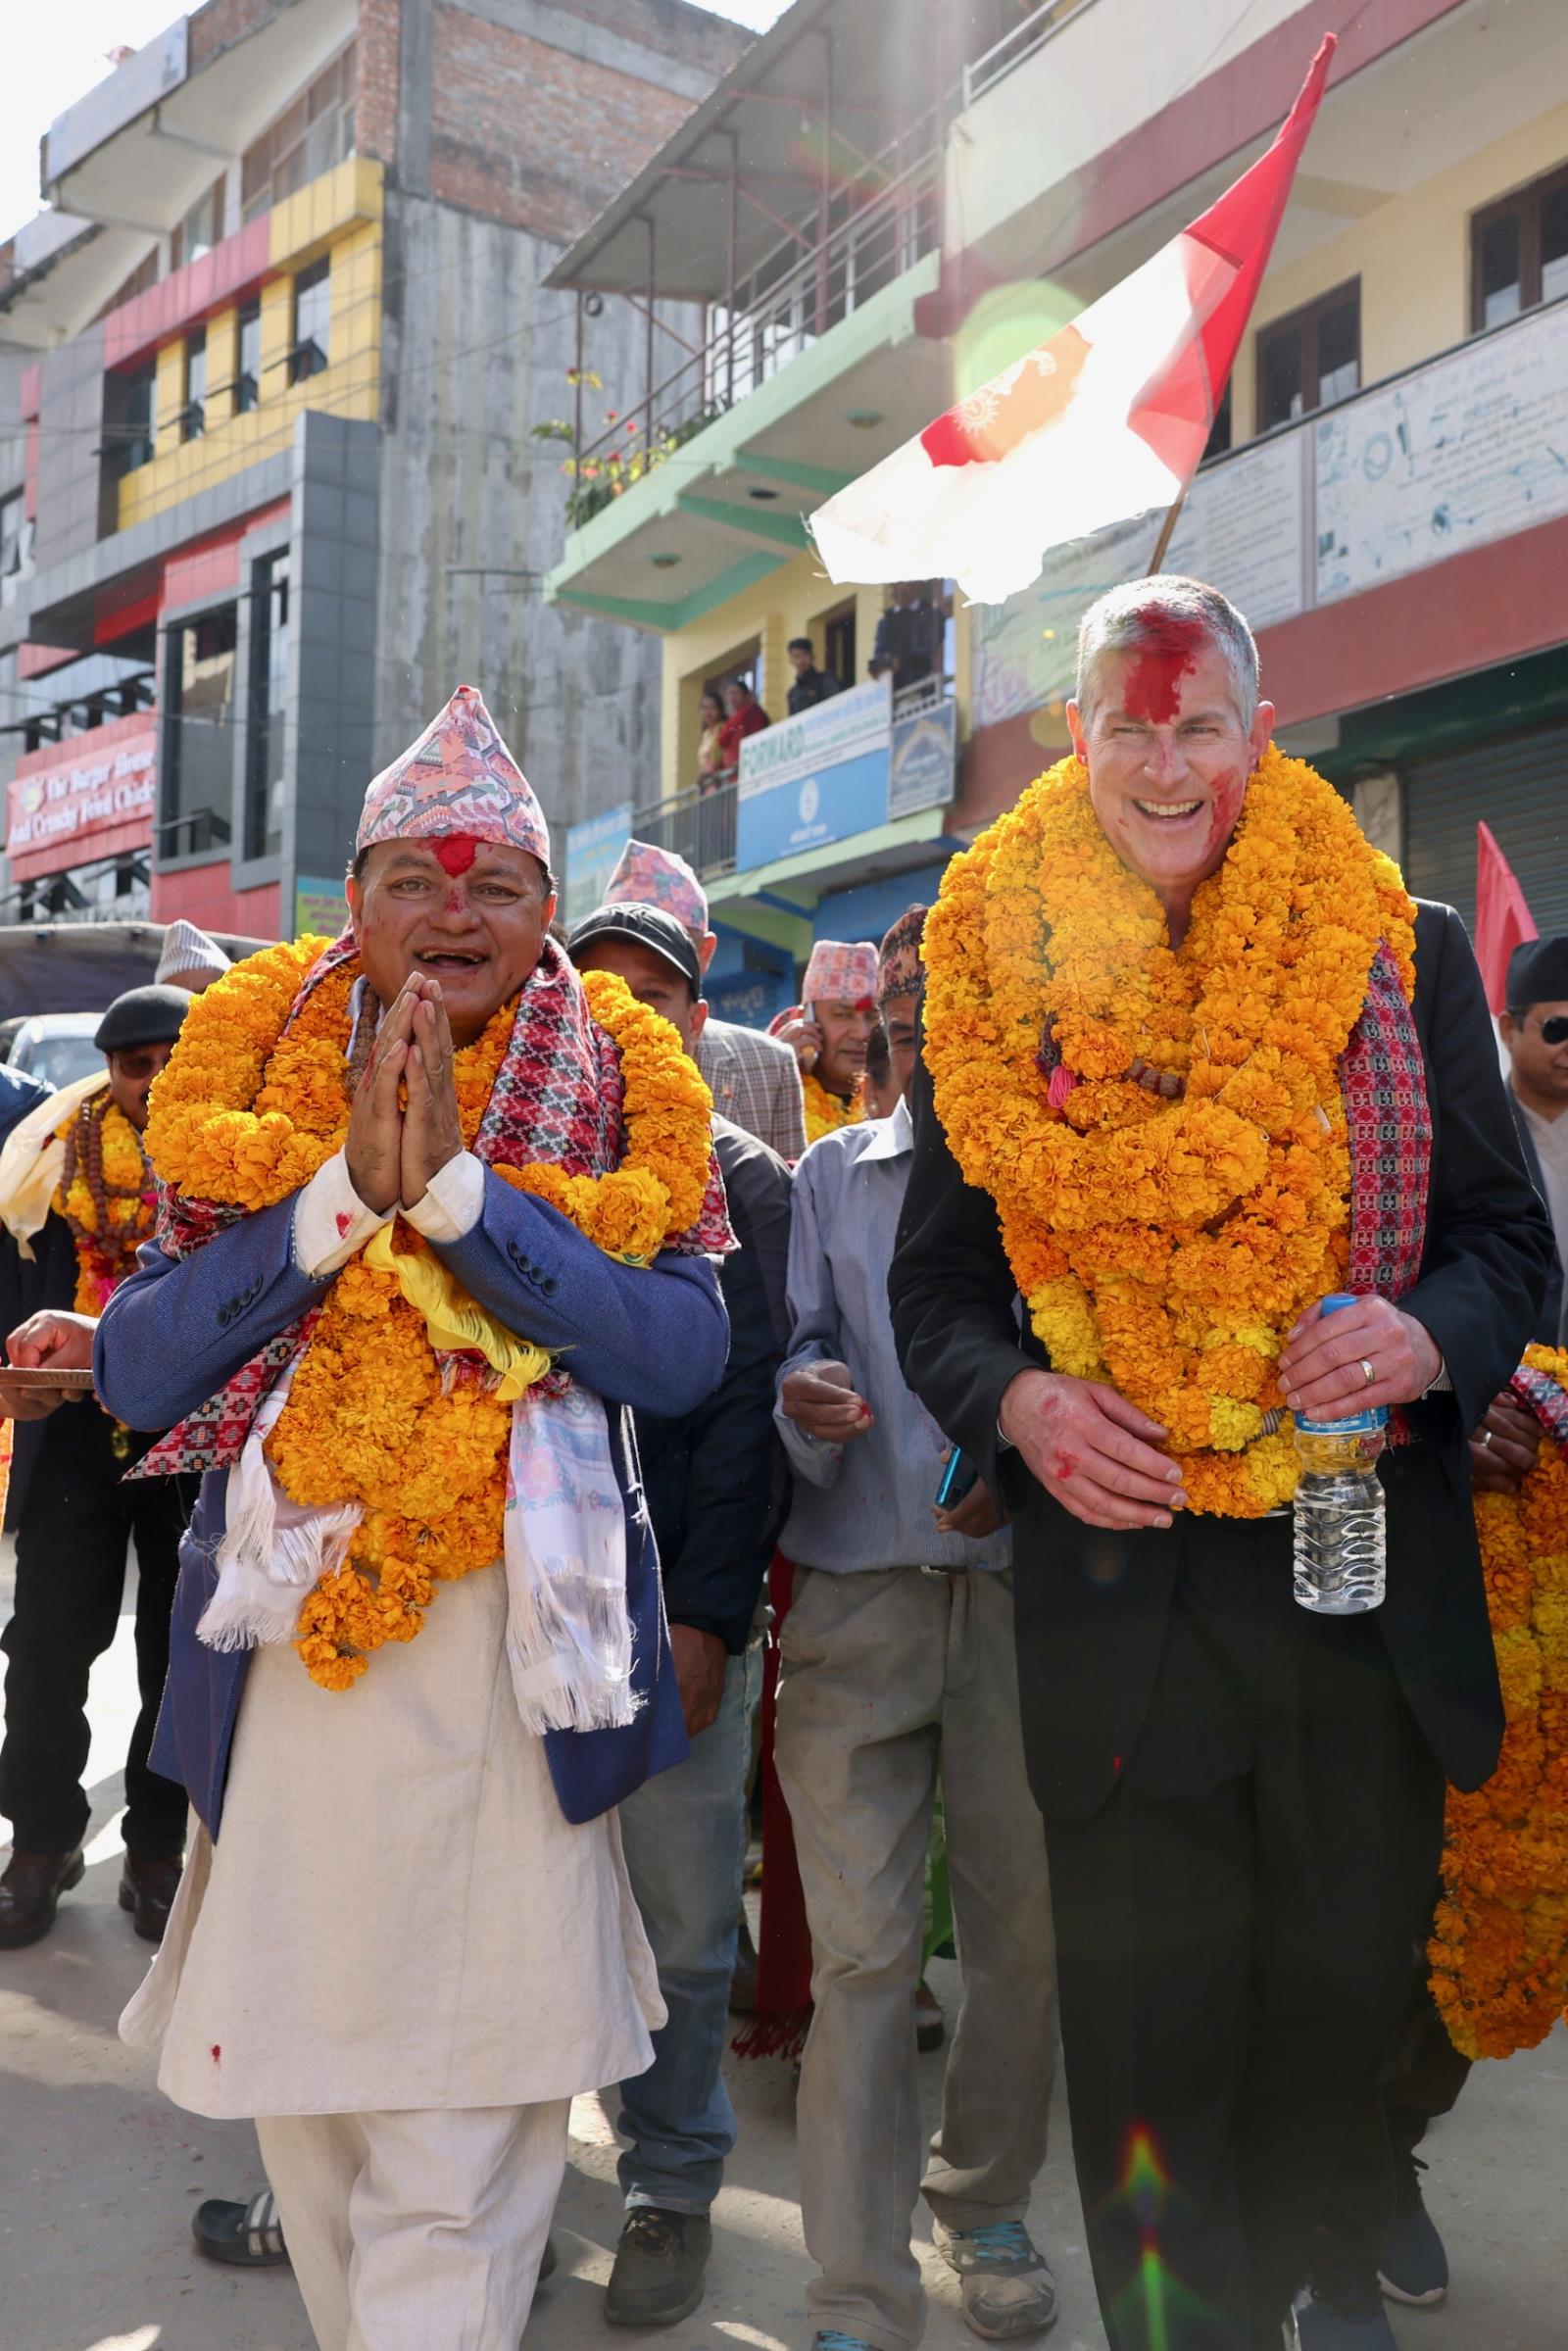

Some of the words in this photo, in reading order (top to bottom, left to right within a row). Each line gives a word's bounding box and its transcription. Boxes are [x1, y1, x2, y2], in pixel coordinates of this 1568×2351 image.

[741, 723, 805, 776] FORWARD
[47, 775, 67, 801] The
[71, 764, 111, 793] Burger
